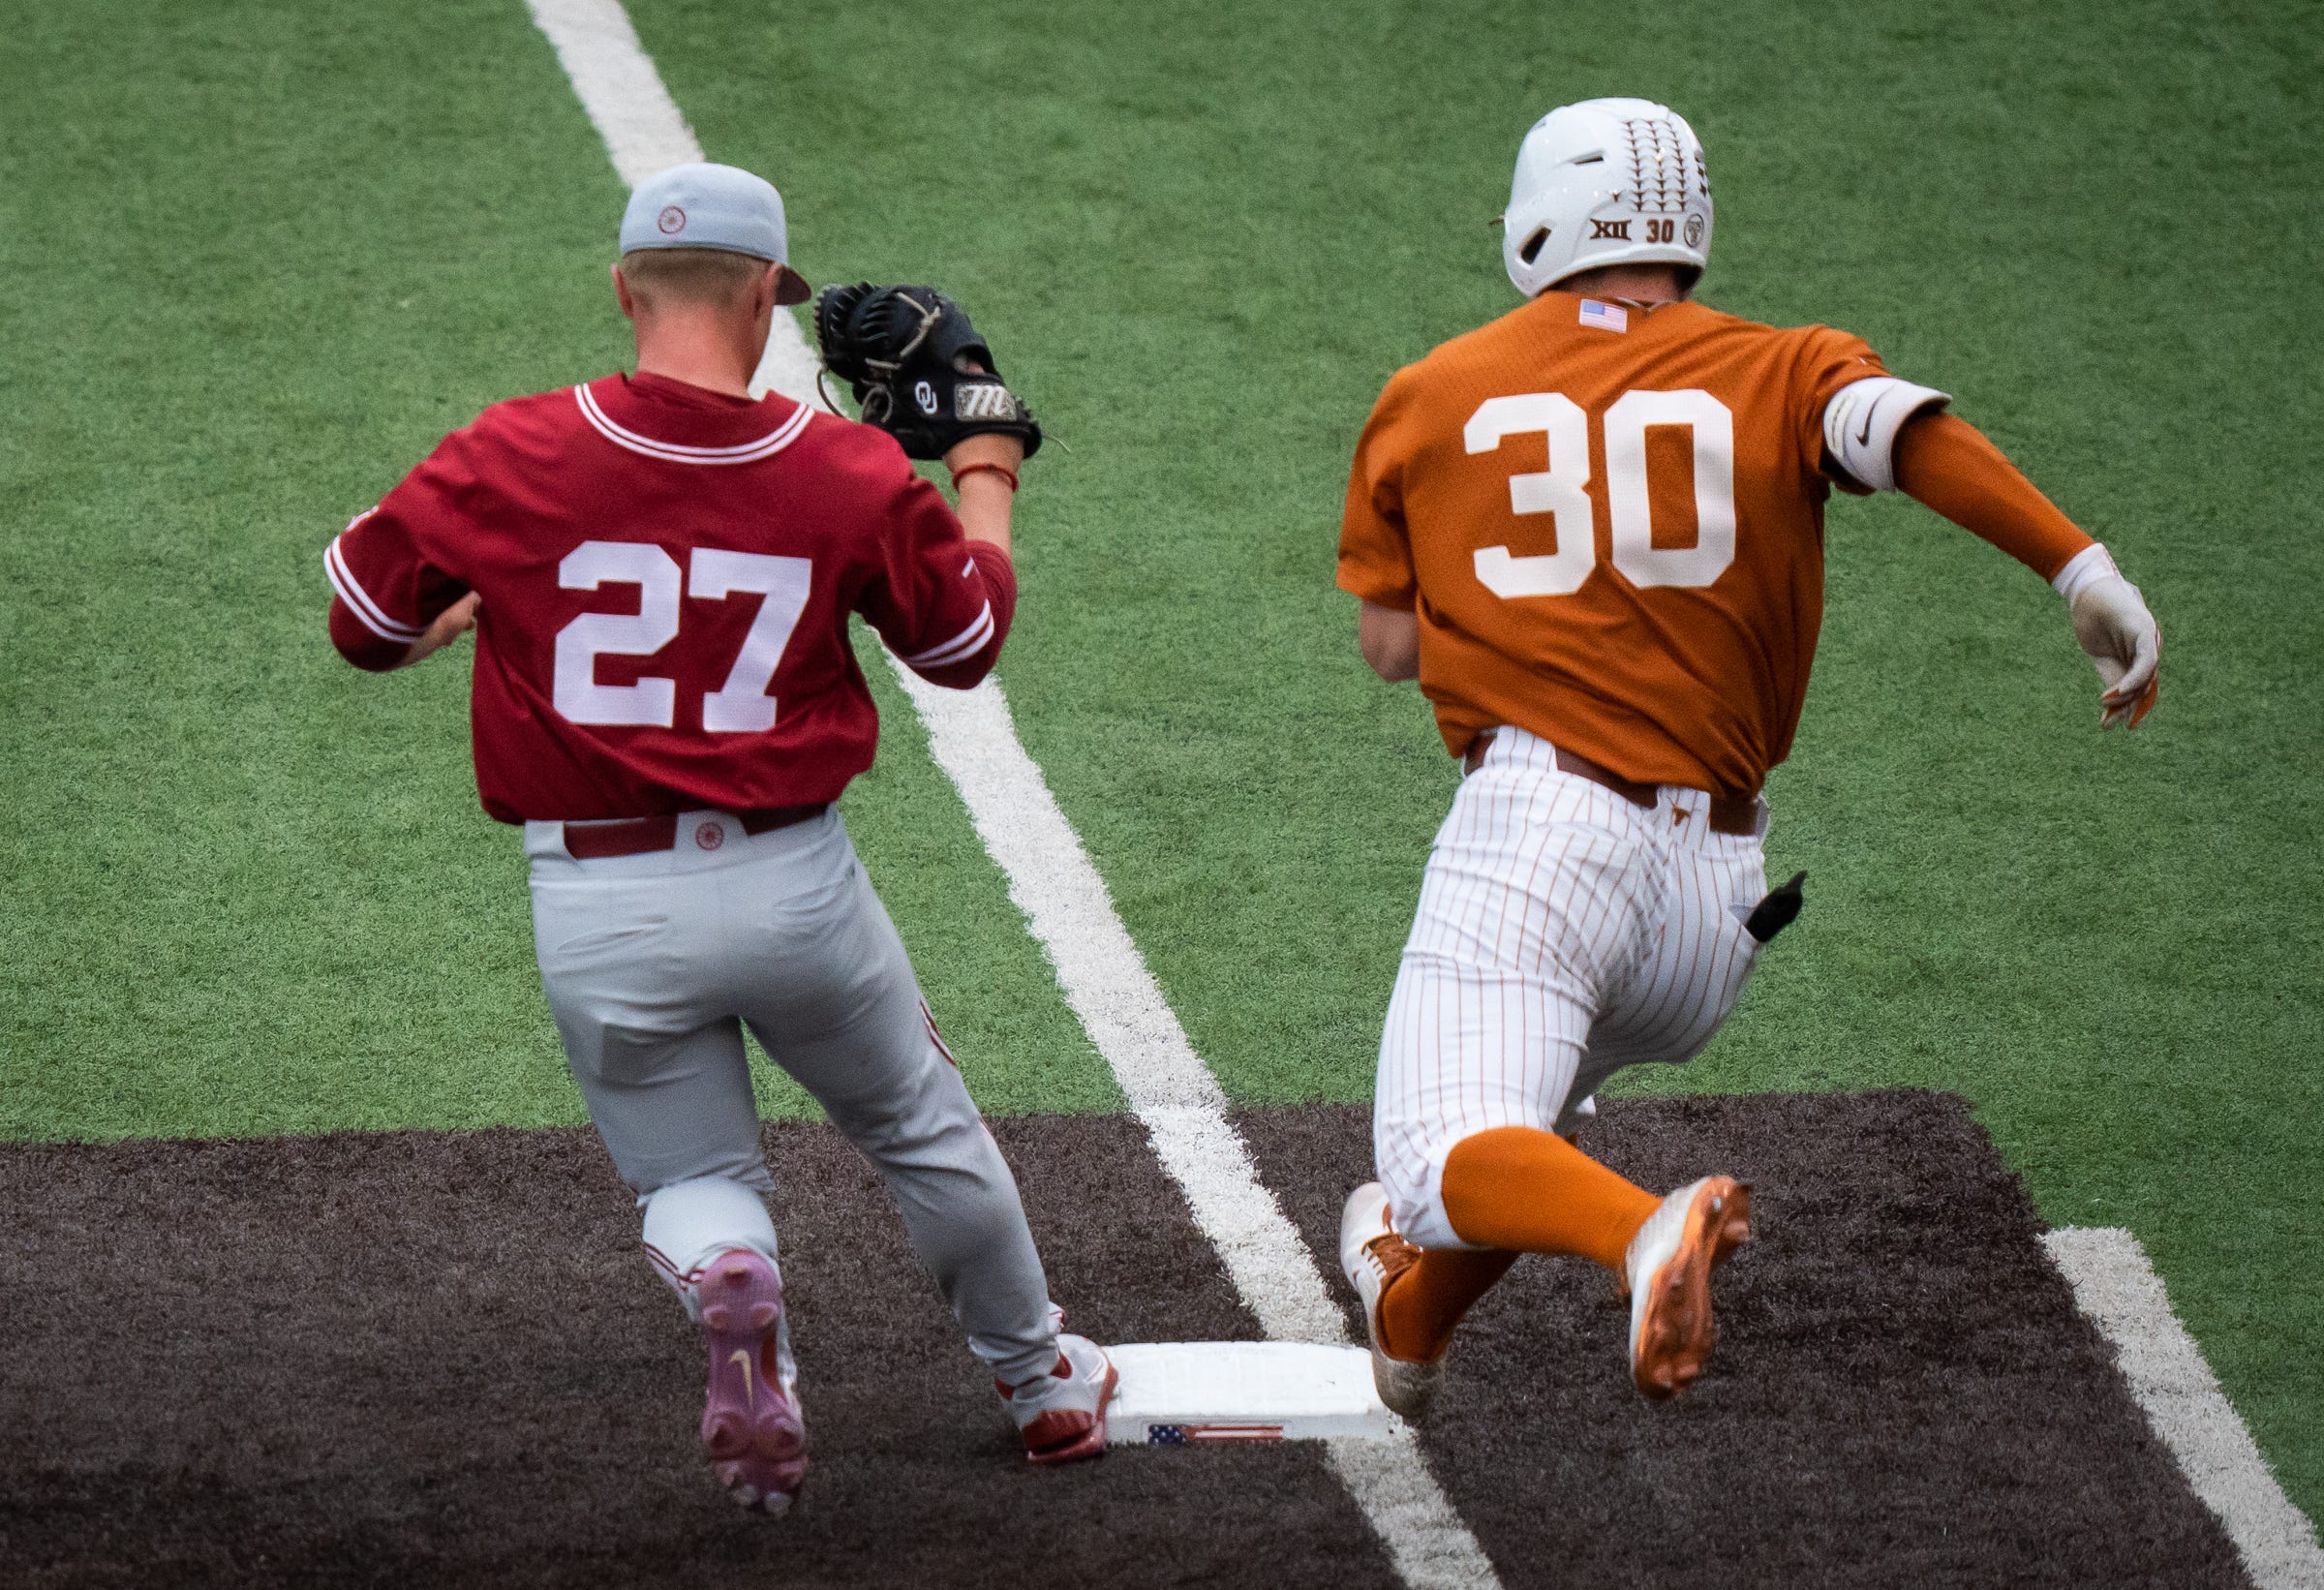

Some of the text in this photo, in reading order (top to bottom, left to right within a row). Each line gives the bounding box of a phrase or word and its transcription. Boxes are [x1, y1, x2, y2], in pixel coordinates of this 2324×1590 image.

[1590, 219, 1632, 241] XII
[1646, 219, 1674, 243] 30
[1463, 389, 1736, 597] 30
[553, 540, 812, 732] 27
